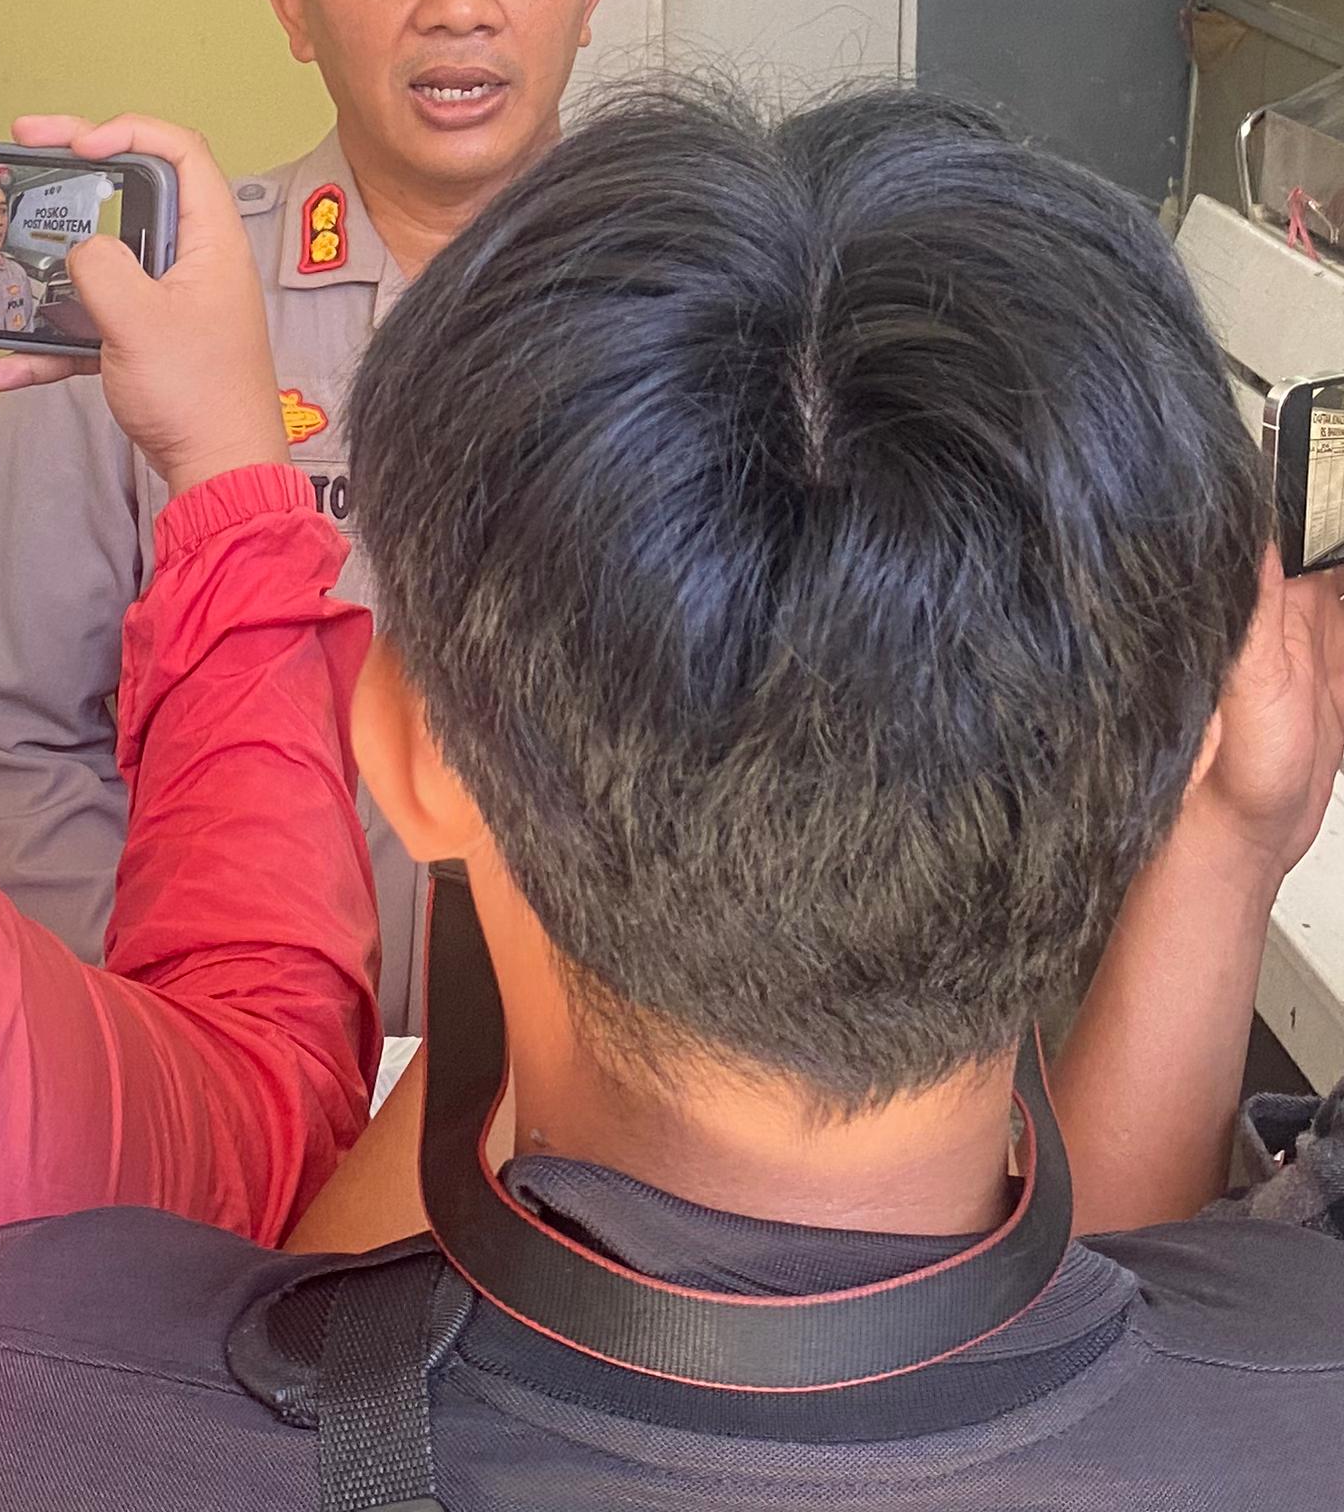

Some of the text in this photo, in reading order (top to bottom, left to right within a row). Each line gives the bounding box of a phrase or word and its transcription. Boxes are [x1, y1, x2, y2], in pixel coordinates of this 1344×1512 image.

[34, 206, 69, 219] POSKO
[22, 218, 92, 235] POST MORTEM
